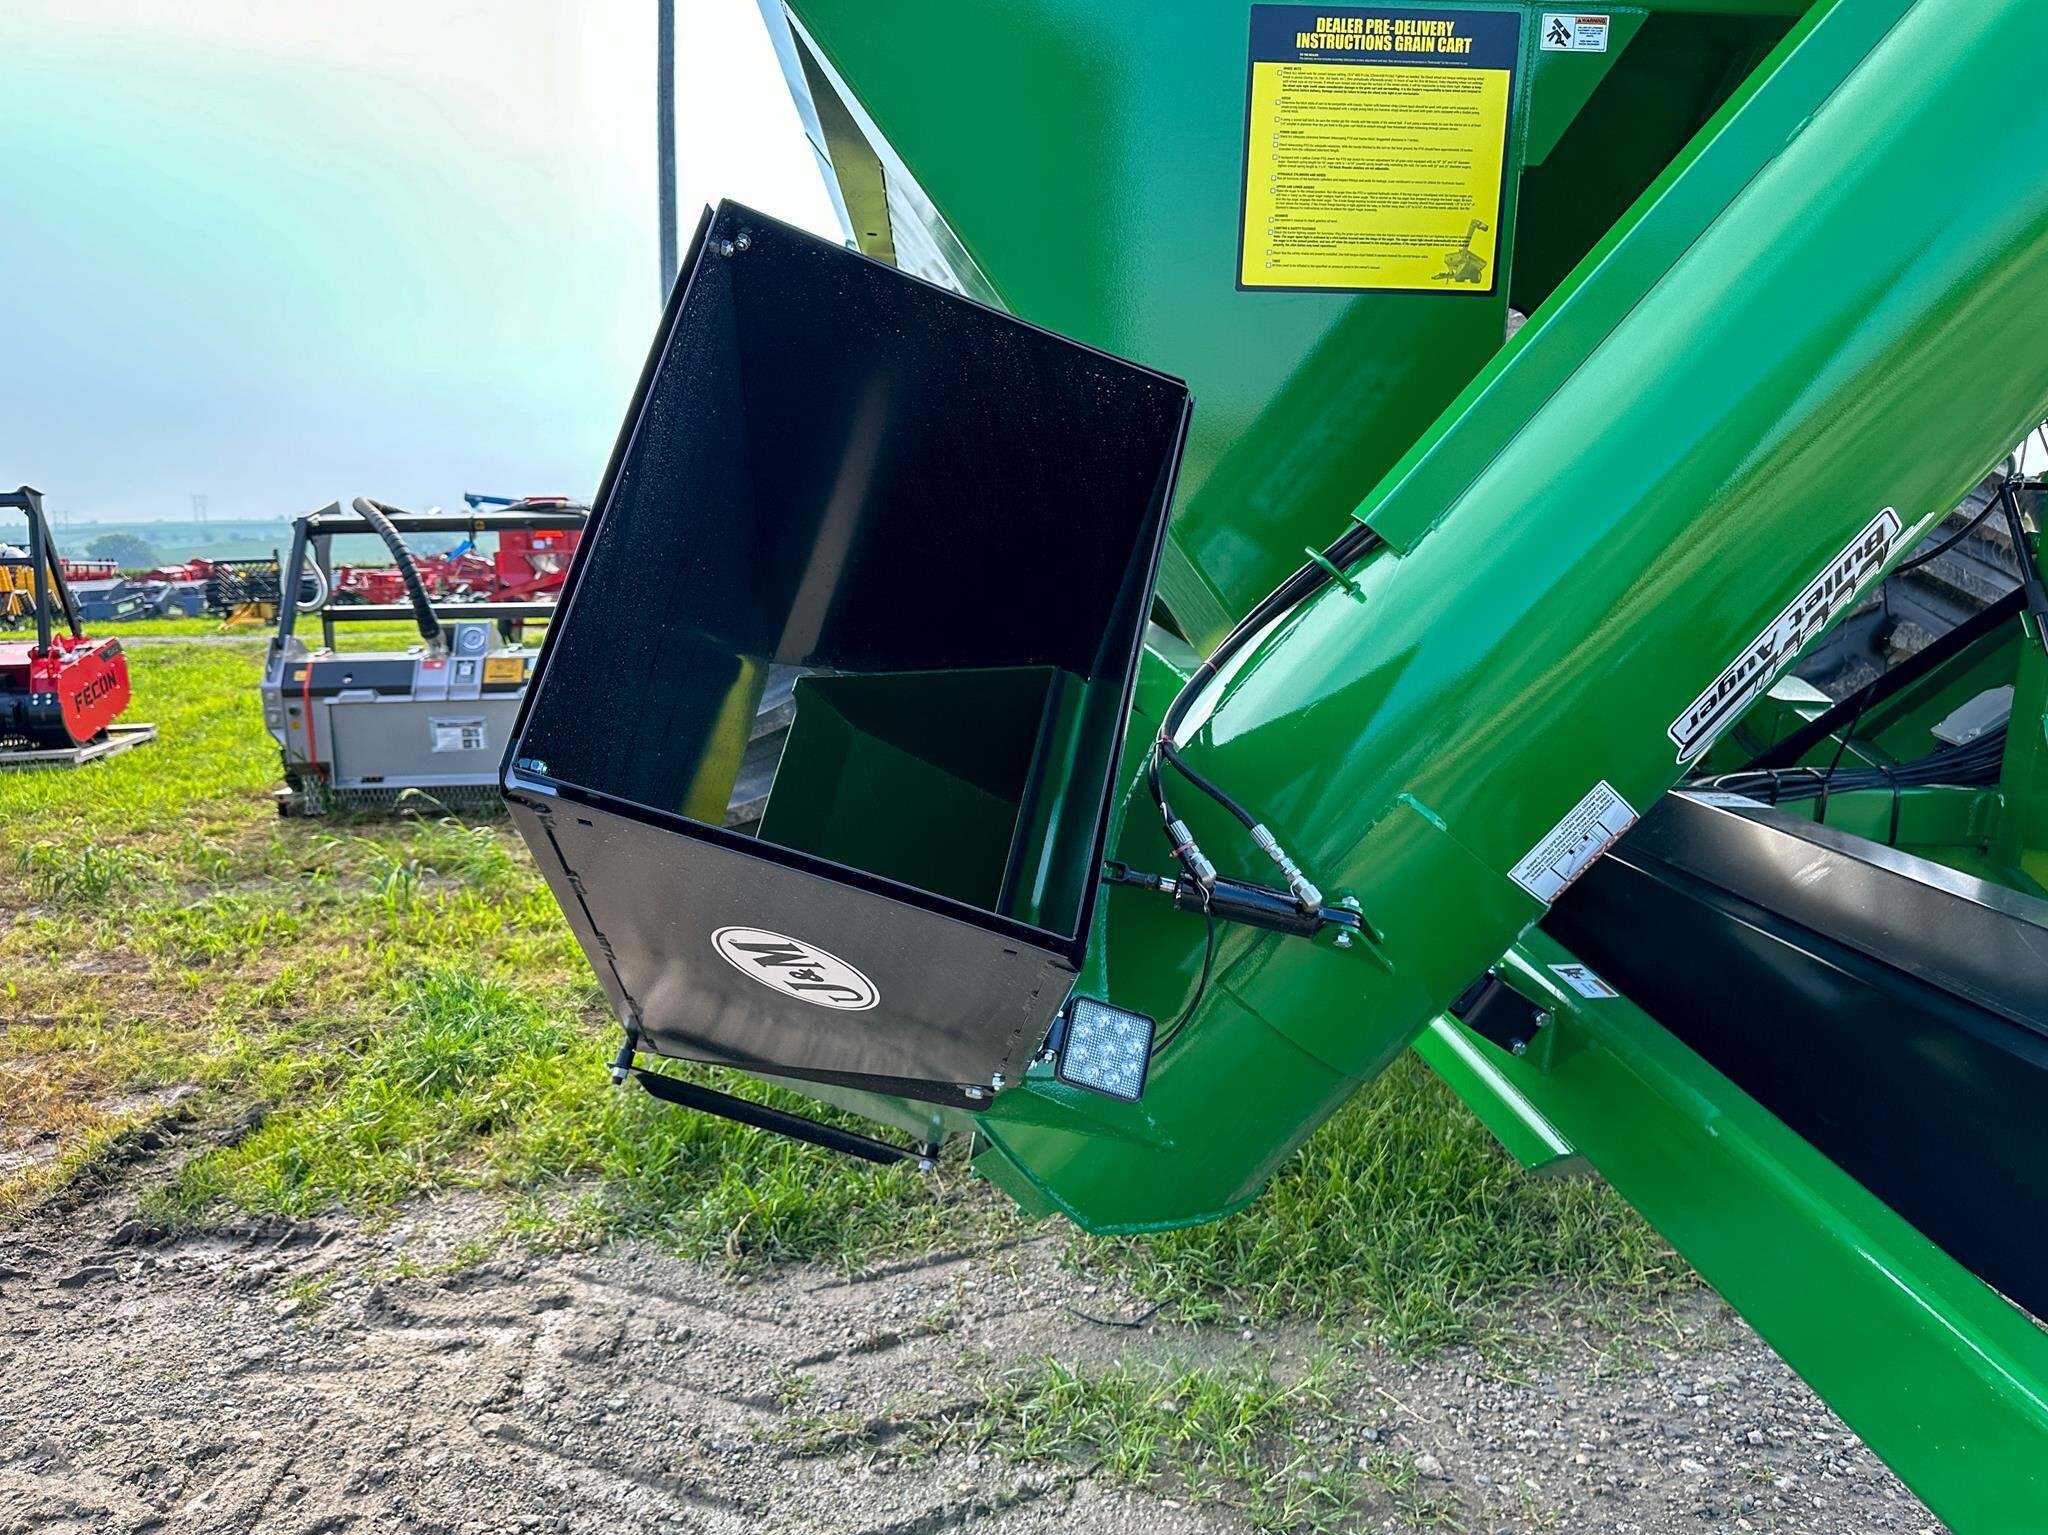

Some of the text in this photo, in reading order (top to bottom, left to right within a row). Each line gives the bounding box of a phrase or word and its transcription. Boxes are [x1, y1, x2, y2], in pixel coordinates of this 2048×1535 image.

[1296, 32, 1473, 54] INSTRUCTIONS GRAIN CART
[1316, 17, 1455, 37] DEALER PRE-DELIVERY
[1685, 522, 1885, 734] Bullet Auger
[74, 669, 117, 713] FECON
[728, 940, 864, 1003] J&M
